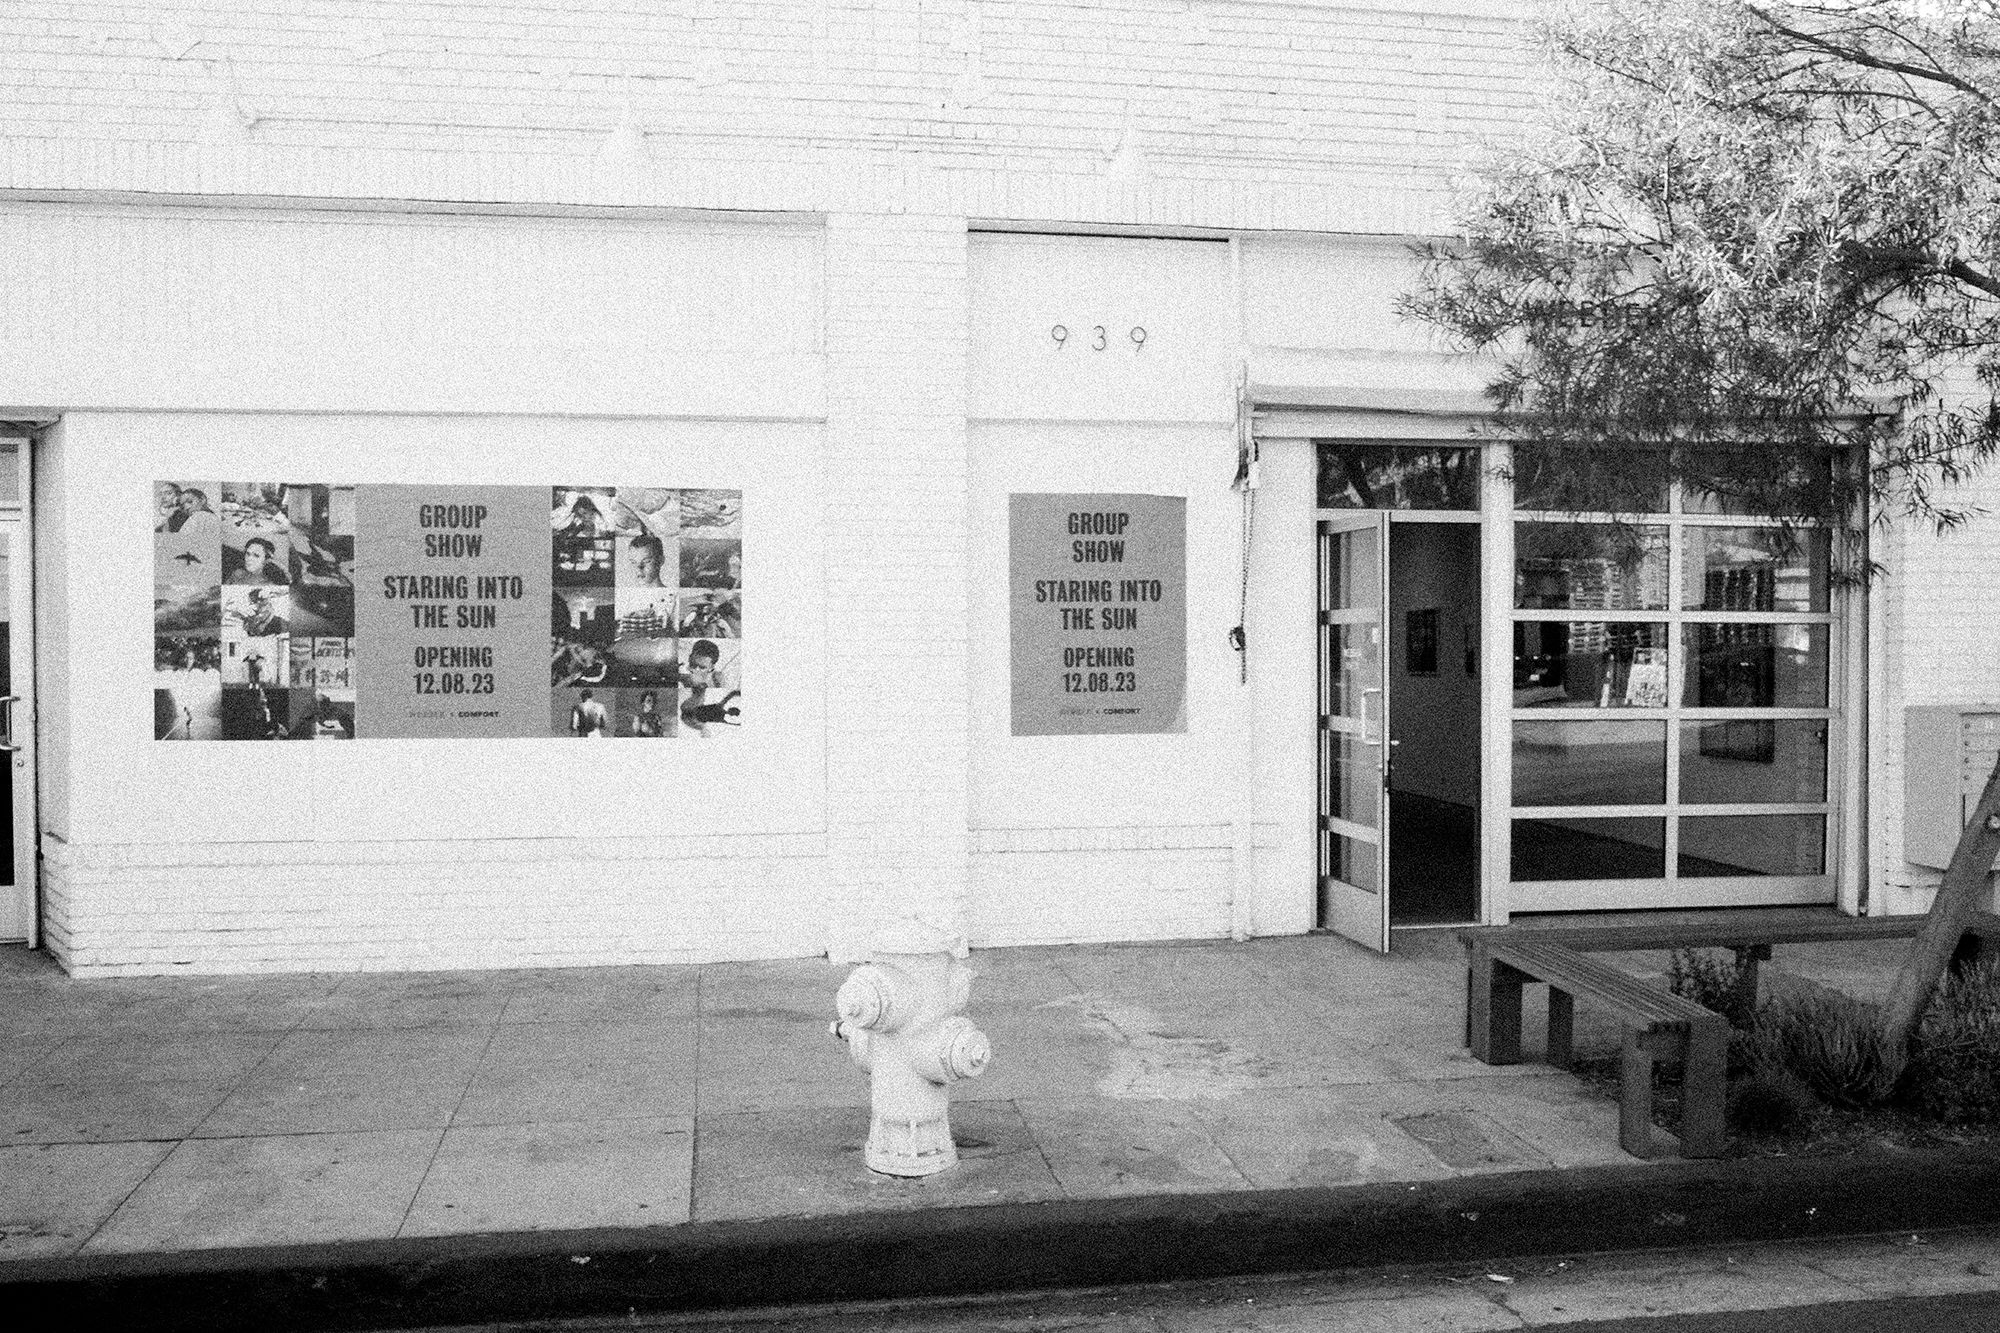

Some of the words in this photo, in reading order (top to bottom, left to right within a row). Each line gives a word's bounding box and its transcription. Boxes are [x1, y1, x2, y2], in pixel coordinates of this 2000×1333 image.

[1051, 324, 1147, 353] 939
[420, 505, 486, 528] GROUP
[1068, 513, 1129, 535] GROUP
[426, 534, 481, 557] SHOW
[1073, 540, 1124, 562] SHOW
[384, 576, 468, 599] STARING
[477, 576, 522, 599] INTO
[1036, 580, 1112, 602] STARING
[1120, 580, 1161, 602] INTO
[411, 605, 448, 628] THE
[457, 605, 495, 628] SUN
[1061, 608, 1094, 630] THE
[1102, 608, 1136, 630] SUN
[415, 647, 492, 667] OPENING
[1064, 647, 1134, 667] OPENING
[414, 673, 494, 694] 12.08.23
[1064, 672, 1136, 692] 12.08.23
